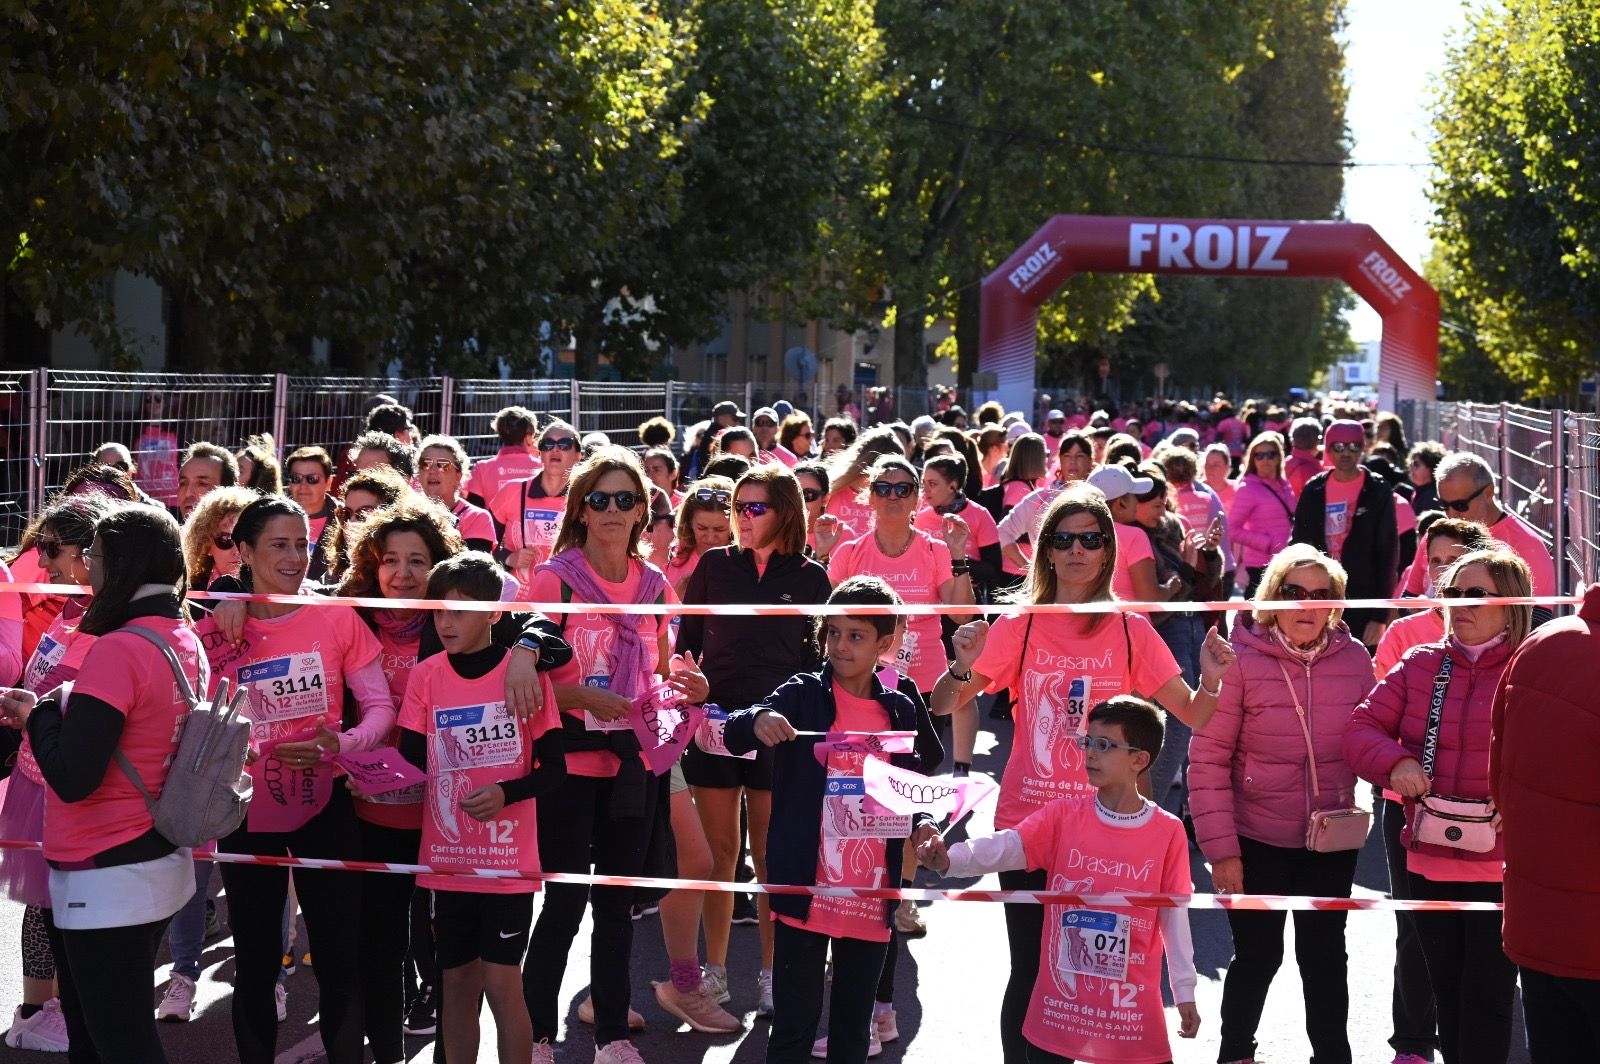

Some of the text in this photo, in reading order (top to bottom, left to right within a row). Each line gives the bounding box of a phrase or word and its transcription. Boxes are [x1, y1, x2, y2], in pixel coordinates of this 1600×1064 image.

[1128, 223, 1291, 271] FROIZ
[1008, 241, 1057, 288] FROIZ
[1364, 250, 1412, 299] FROIZ
[543, 521, 561, 532] 34
[272, 673, 323, 696] 3114
[294, 692, 323, 701] Carrera
[1431, 682, 1446, 723] JAGAS
[465, 722, 516, 744] 3113
[487, 740, 517, 749] Carrera
[1022, 776, 1056, 789] Carrera
[1058, 780, 1071, 790] de
[1073, 781, 1084, 791] la
[430, 844, 519, 857] Carrera de la Mujer
[466, 858, 519, 866] DRASANVI
[1043, 995, 1144, 1022] Carrera de la Mujer
[1042, 1018, 1065, 1030] Contra
[1105, 1031, 1116, 1040] de
[1080, 1018, 1144, 1032] DRASANVI
